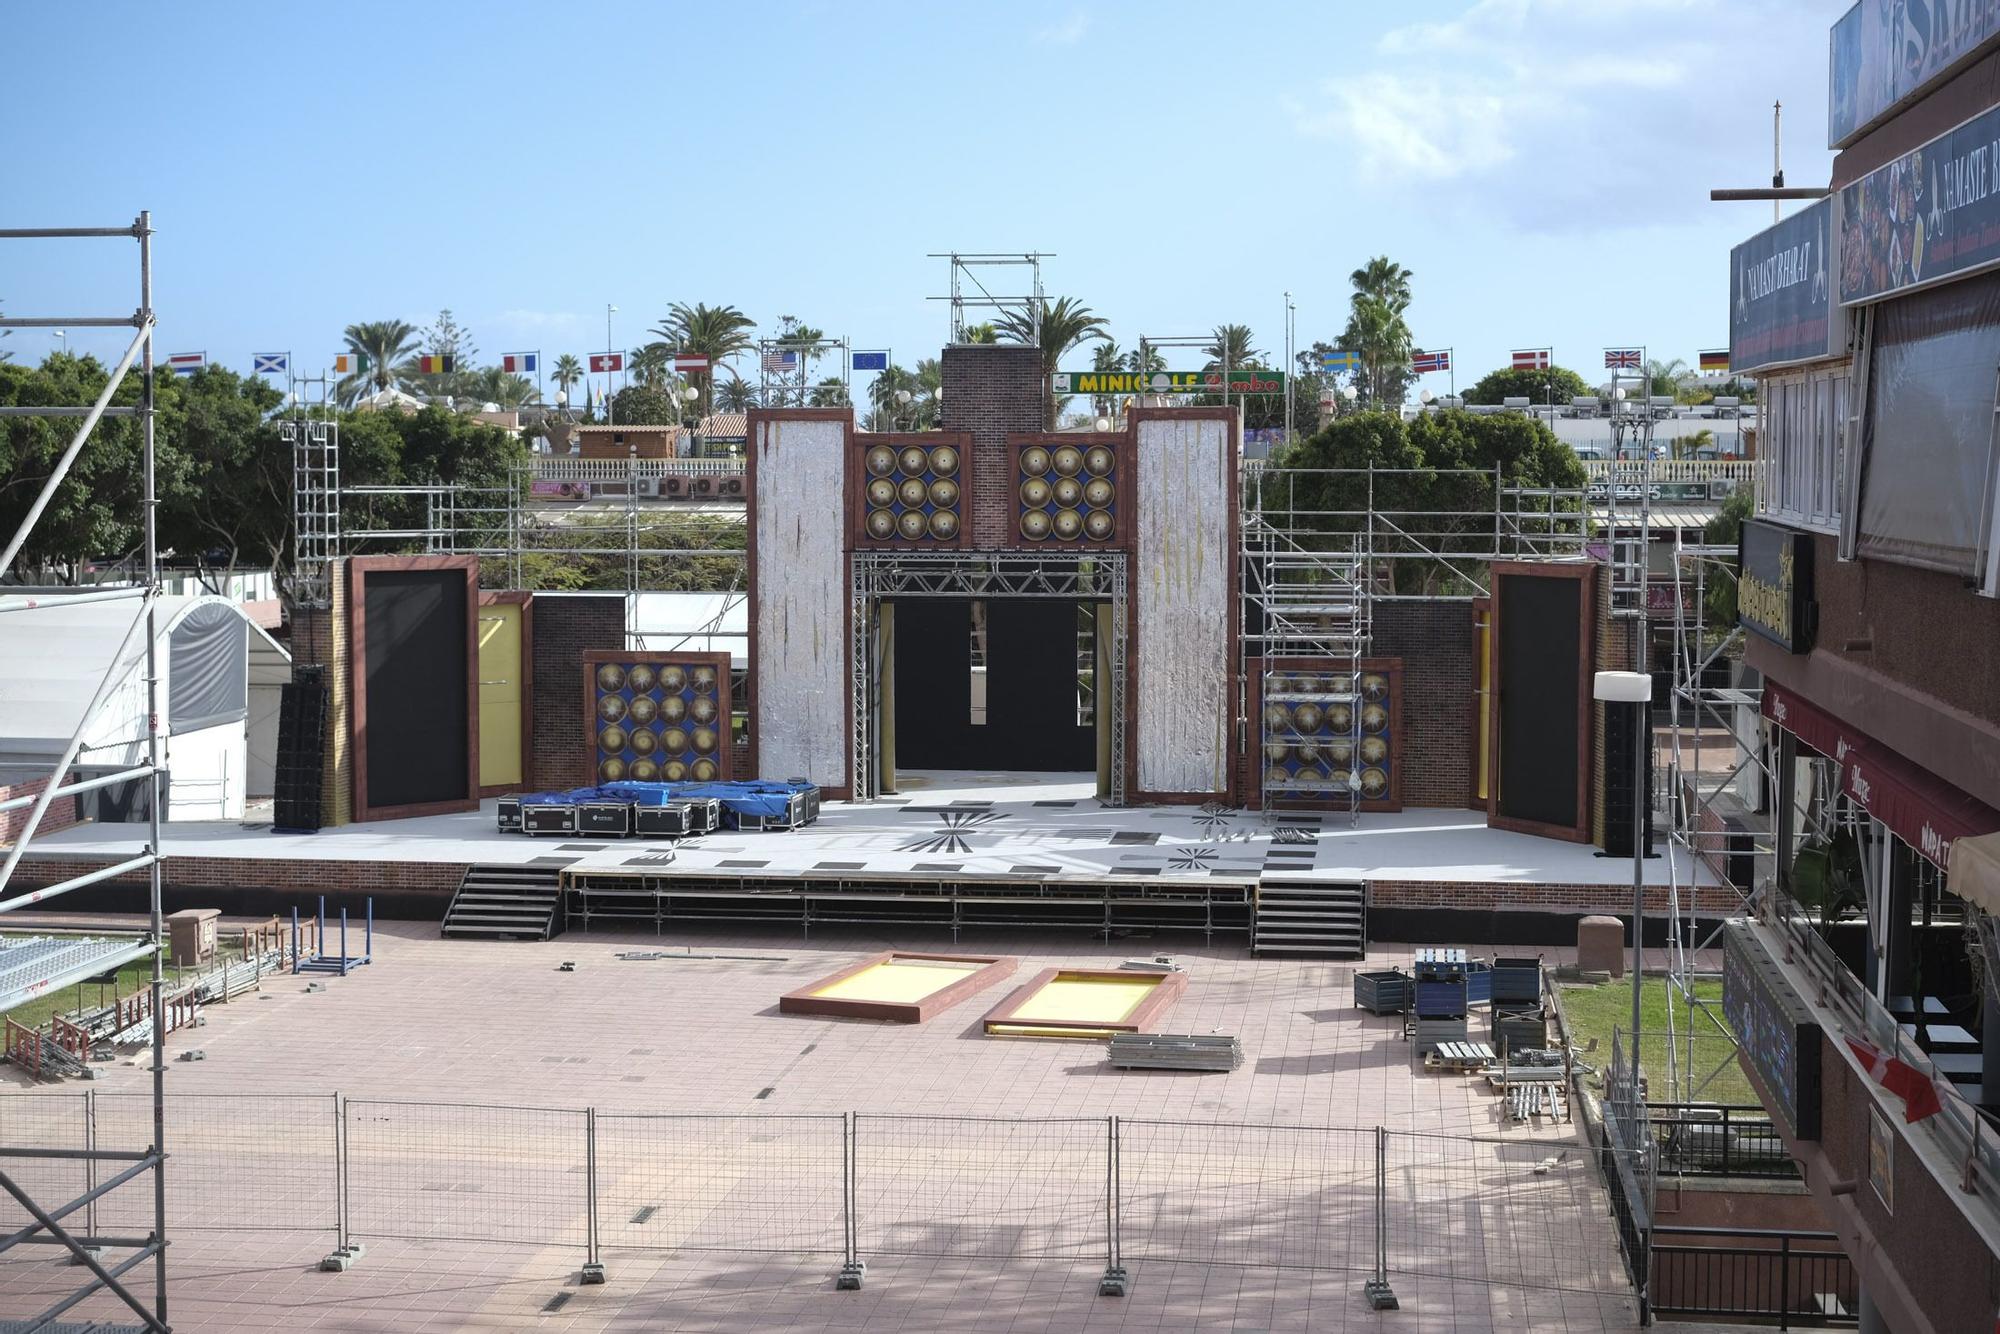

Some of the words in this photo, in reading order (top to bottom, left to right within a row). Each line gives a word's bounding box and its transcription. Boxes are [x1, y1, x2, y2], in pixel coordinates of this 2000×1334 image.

[1943, 145, 1988, 214] NAMASTE
[1991, 138, 2000, 194] B
[1777, 241, 1811, 290] BHARAT
